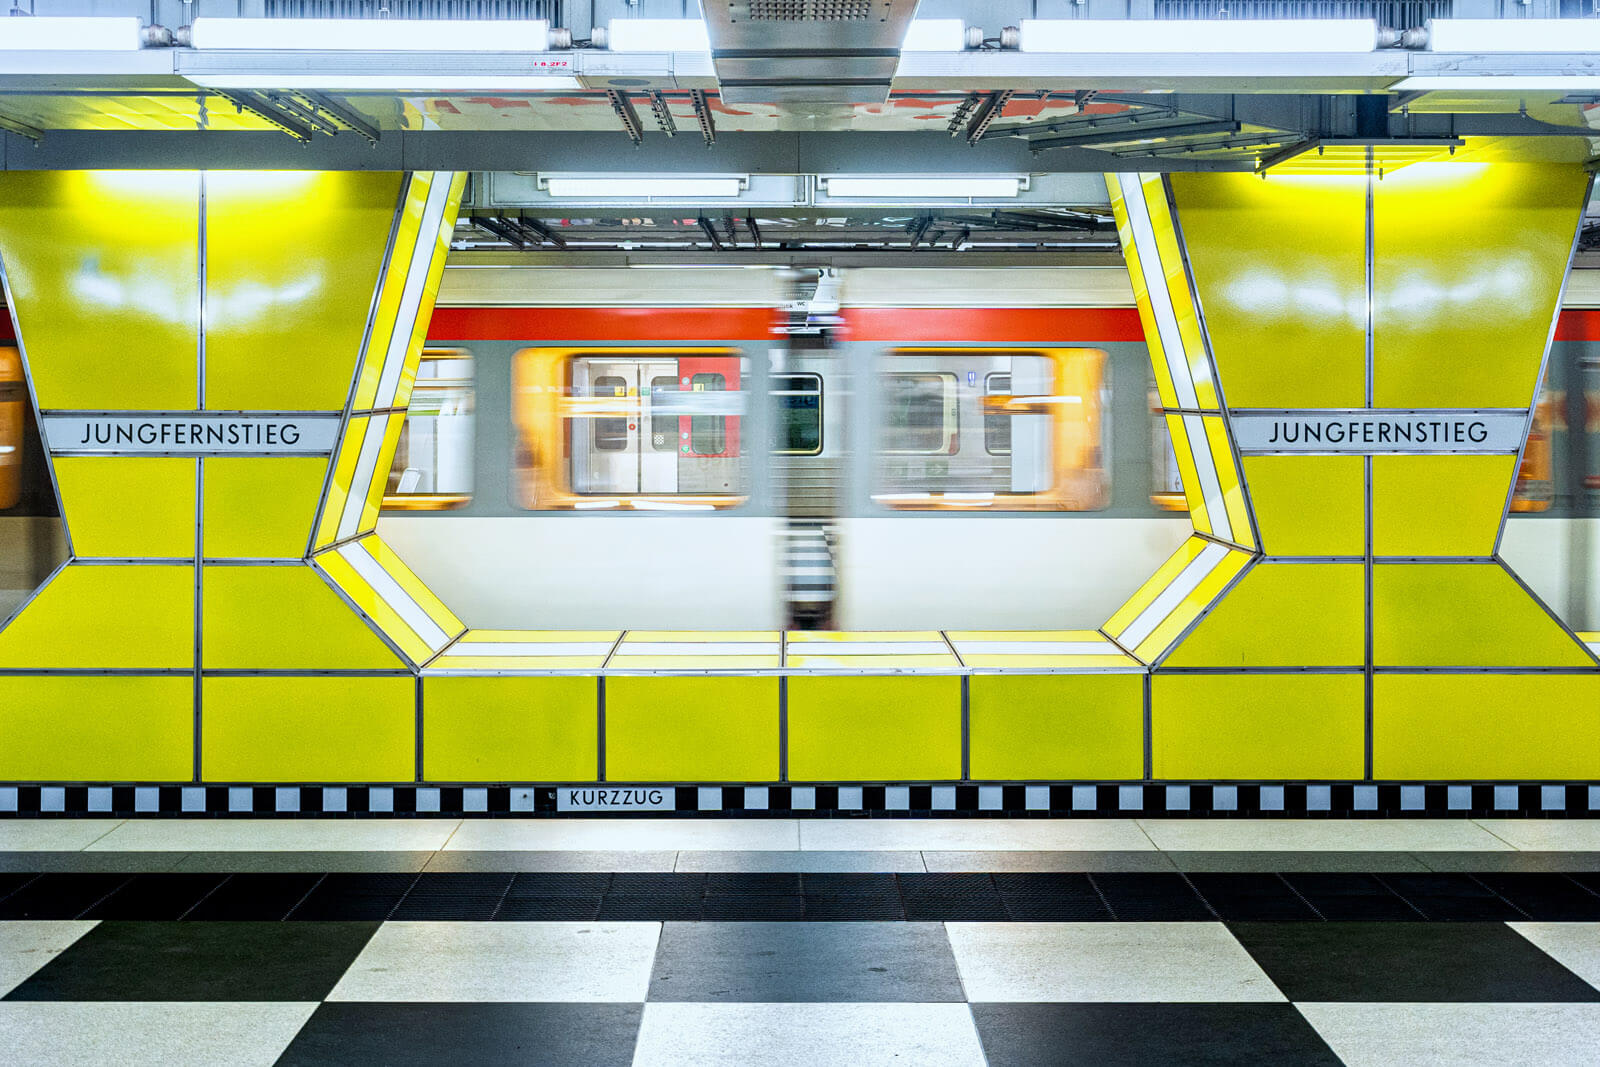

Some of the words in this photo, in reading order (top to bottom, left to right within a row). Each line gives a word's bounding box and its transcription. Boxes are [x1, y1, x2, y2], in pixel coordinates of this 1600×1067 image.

[81, 423, 300, 445] JUNGFERNSTIEG
[1269, 422, 1488, 443] JUNGFERNSTIEG
[570, 790, 663, 805] KURZZUG
